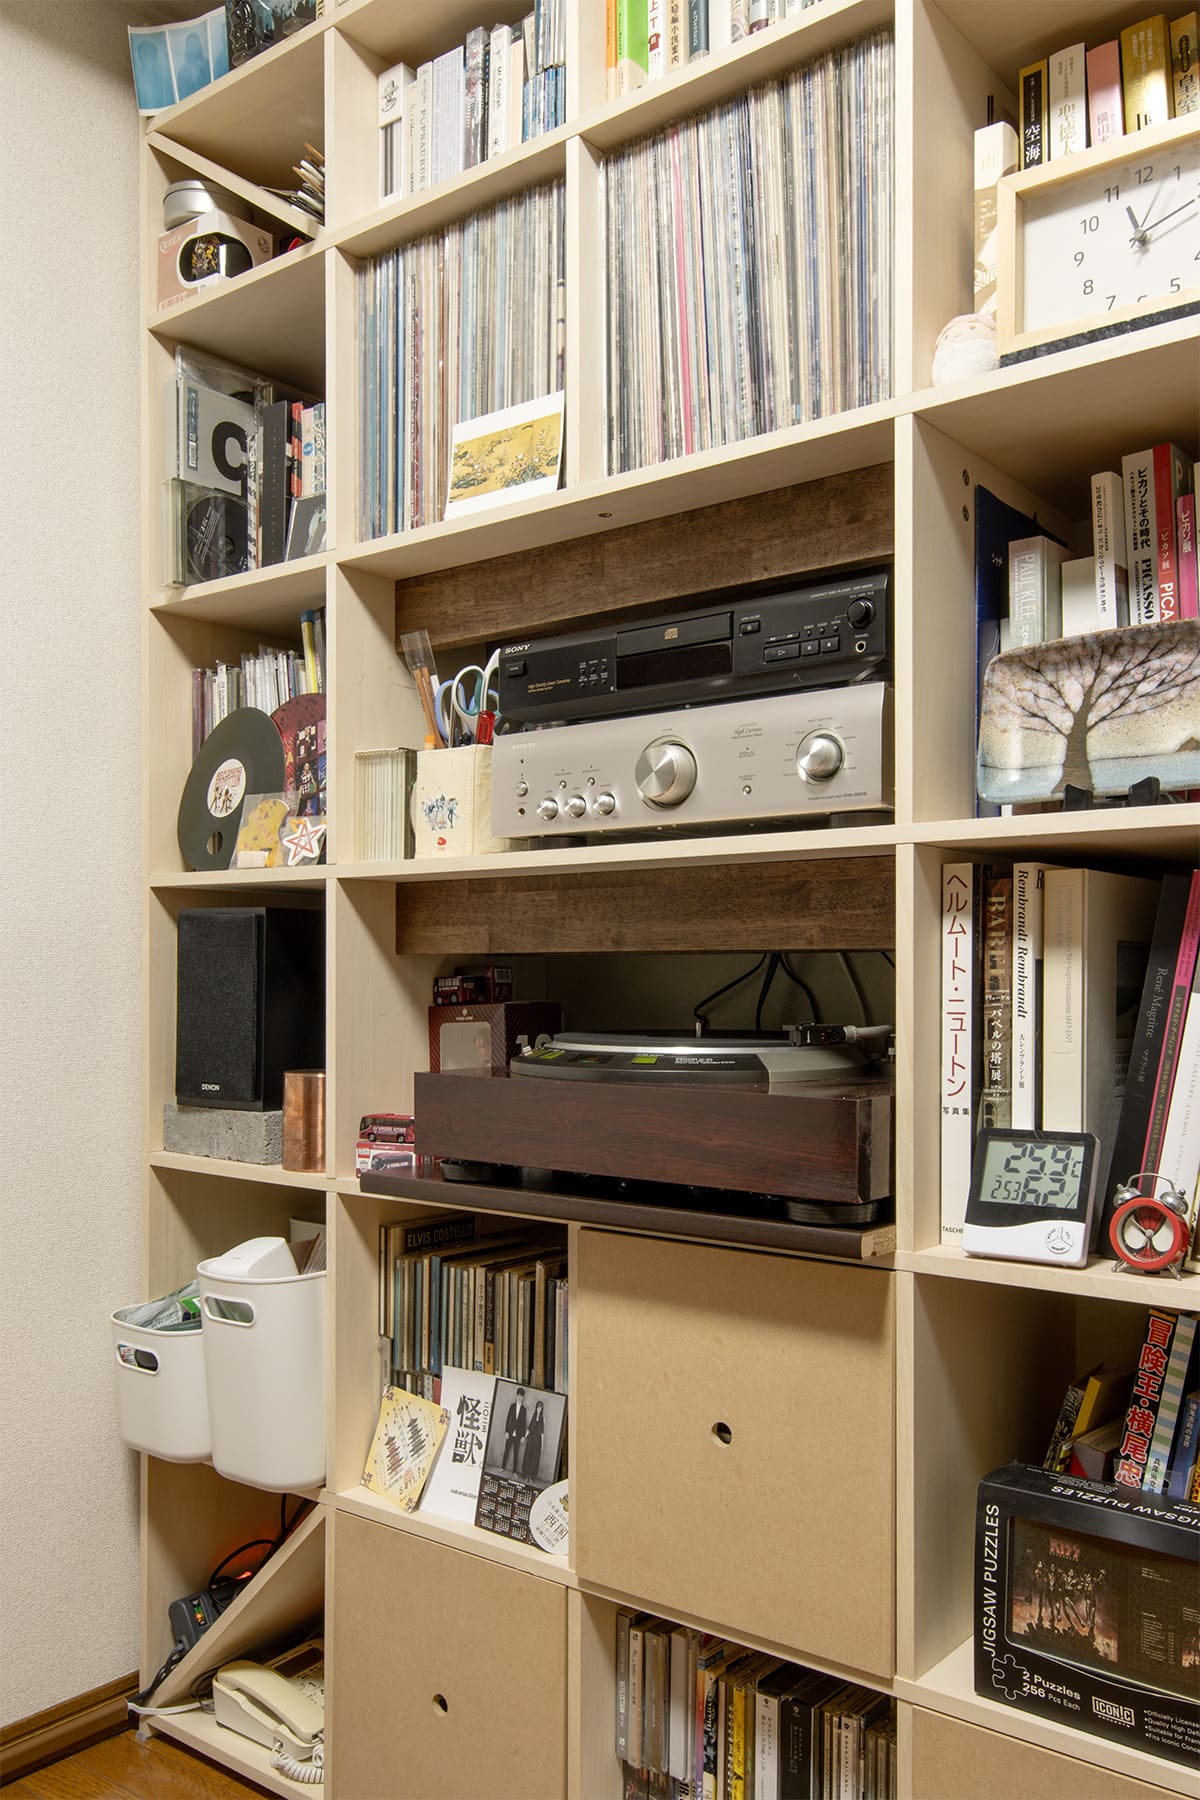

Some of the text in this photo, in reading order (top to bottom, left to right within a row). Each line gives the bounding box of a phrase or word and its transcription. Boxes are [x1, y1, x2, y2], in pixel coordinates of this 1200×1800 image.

[1134, 166, 1153, 185] 12
[1172, 165, 1181, 181] 1
[1103, 185, 1120, 203] 11
[1080, 215, 1100, 235] 10
[1073, 251, 1085, 268] 9
[1083, 279, 1094, 296] 8
[1170, 277, 1181, 294] 5
[1105, 295, 1117, 311] 7
[1141, 558, 1155, 620] PICASSO
[1160, 582, 1175, 621] PICA
[504, 644, 531, 655] SONY
[1017, 869, 1029, 1018] Rembrandt Rembrandt
[946, 874, 968, 1097] ヘルムート・ニュートン
[201, 1083, 220, 1092] DENON
[407, 1223, 474, 1248] ELVIS COSTELLO
[1114, 1316, 1174, 1489] 冒険王・横尾忠
[451, 1394, 483, 1465] 怪獣
[1050, 1484, 1131, 1508] PUZZLES
[1133, 1504, 1200, 1529] IGSAW
[982, 1504, 1000, 1658] JIGSAW PUZZLES
[1022, 1671, 1081, 1701] 2 Puzzles
[1022, 1682, 1081, 1712] 256 Pcs Each
